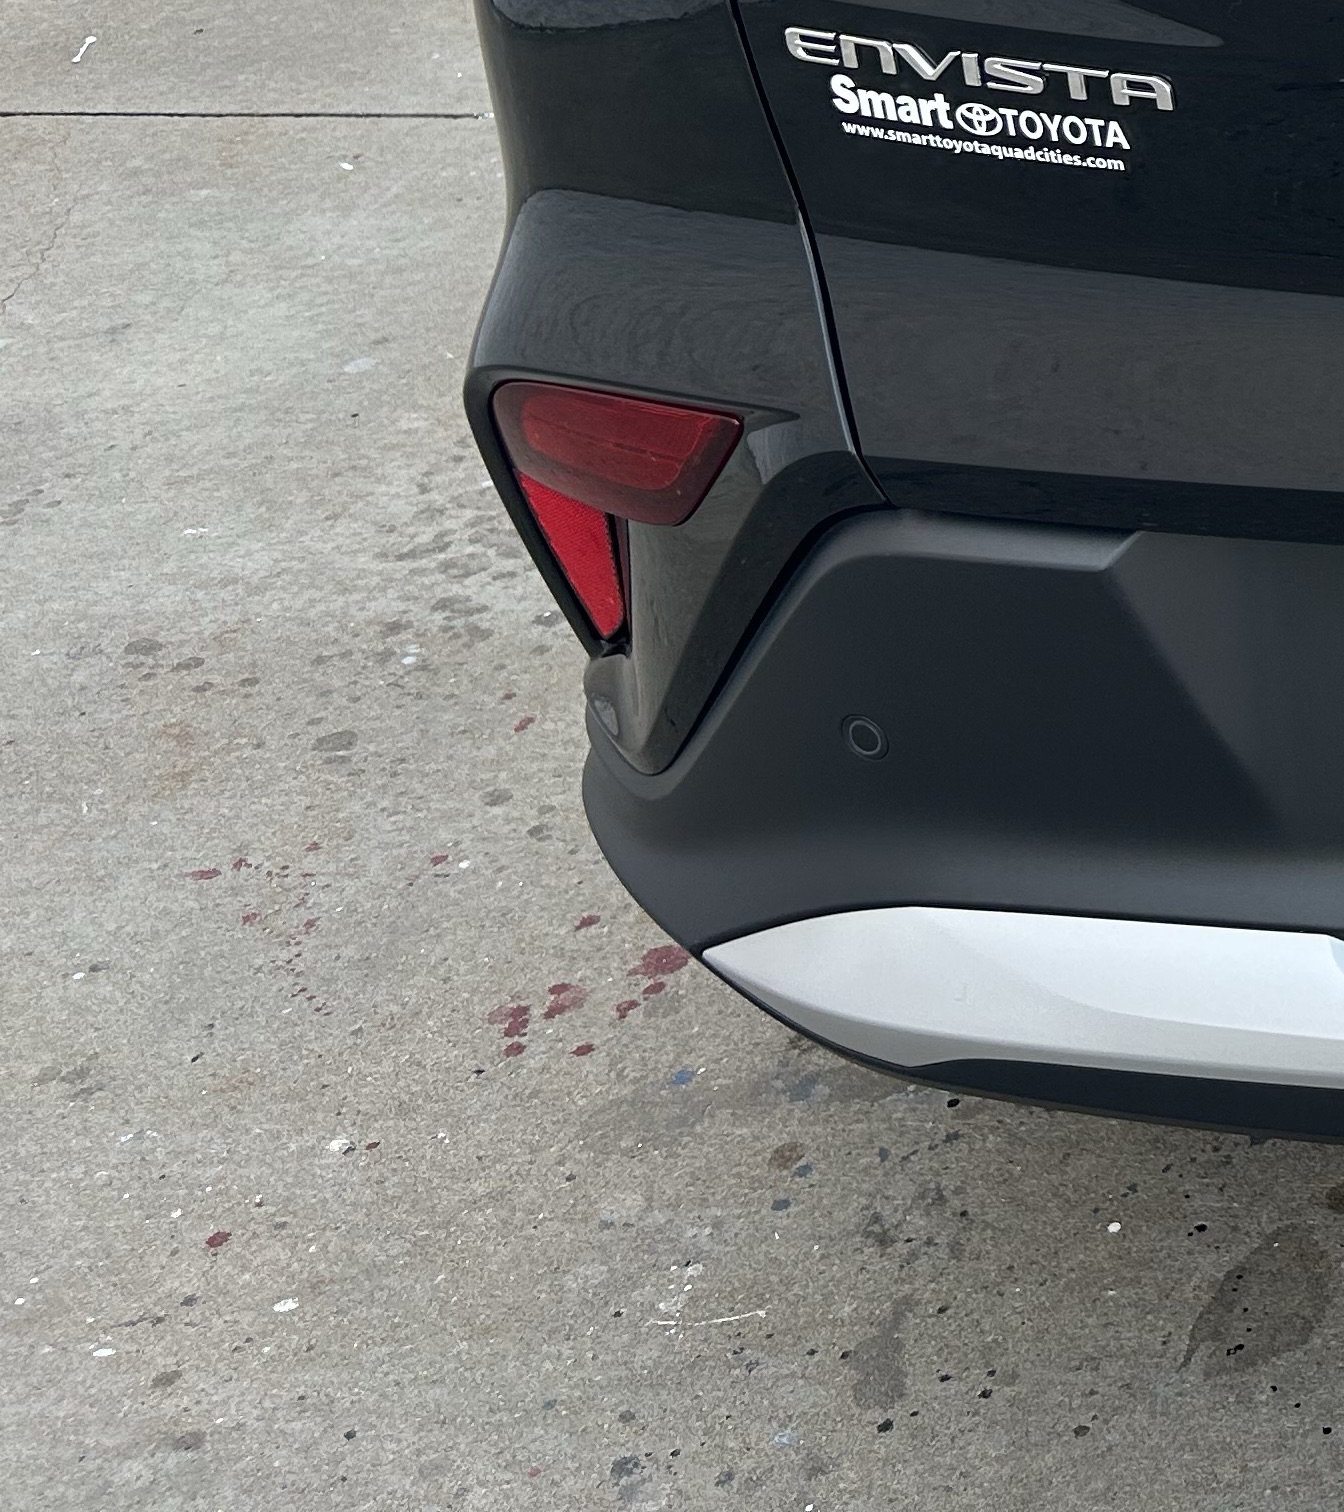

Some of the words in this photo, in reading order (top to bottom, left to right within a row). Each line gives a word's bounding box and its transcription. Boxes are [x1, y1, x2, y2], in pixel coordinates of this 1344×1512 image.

[784, 26, 1176, 111] ENVISTA
[830, 74, 954, 130] Smart
[998, 107, 1131, 150] TOYOTA
[842, 121, 1126, 171] www.smarttoyotaquadcities.com
